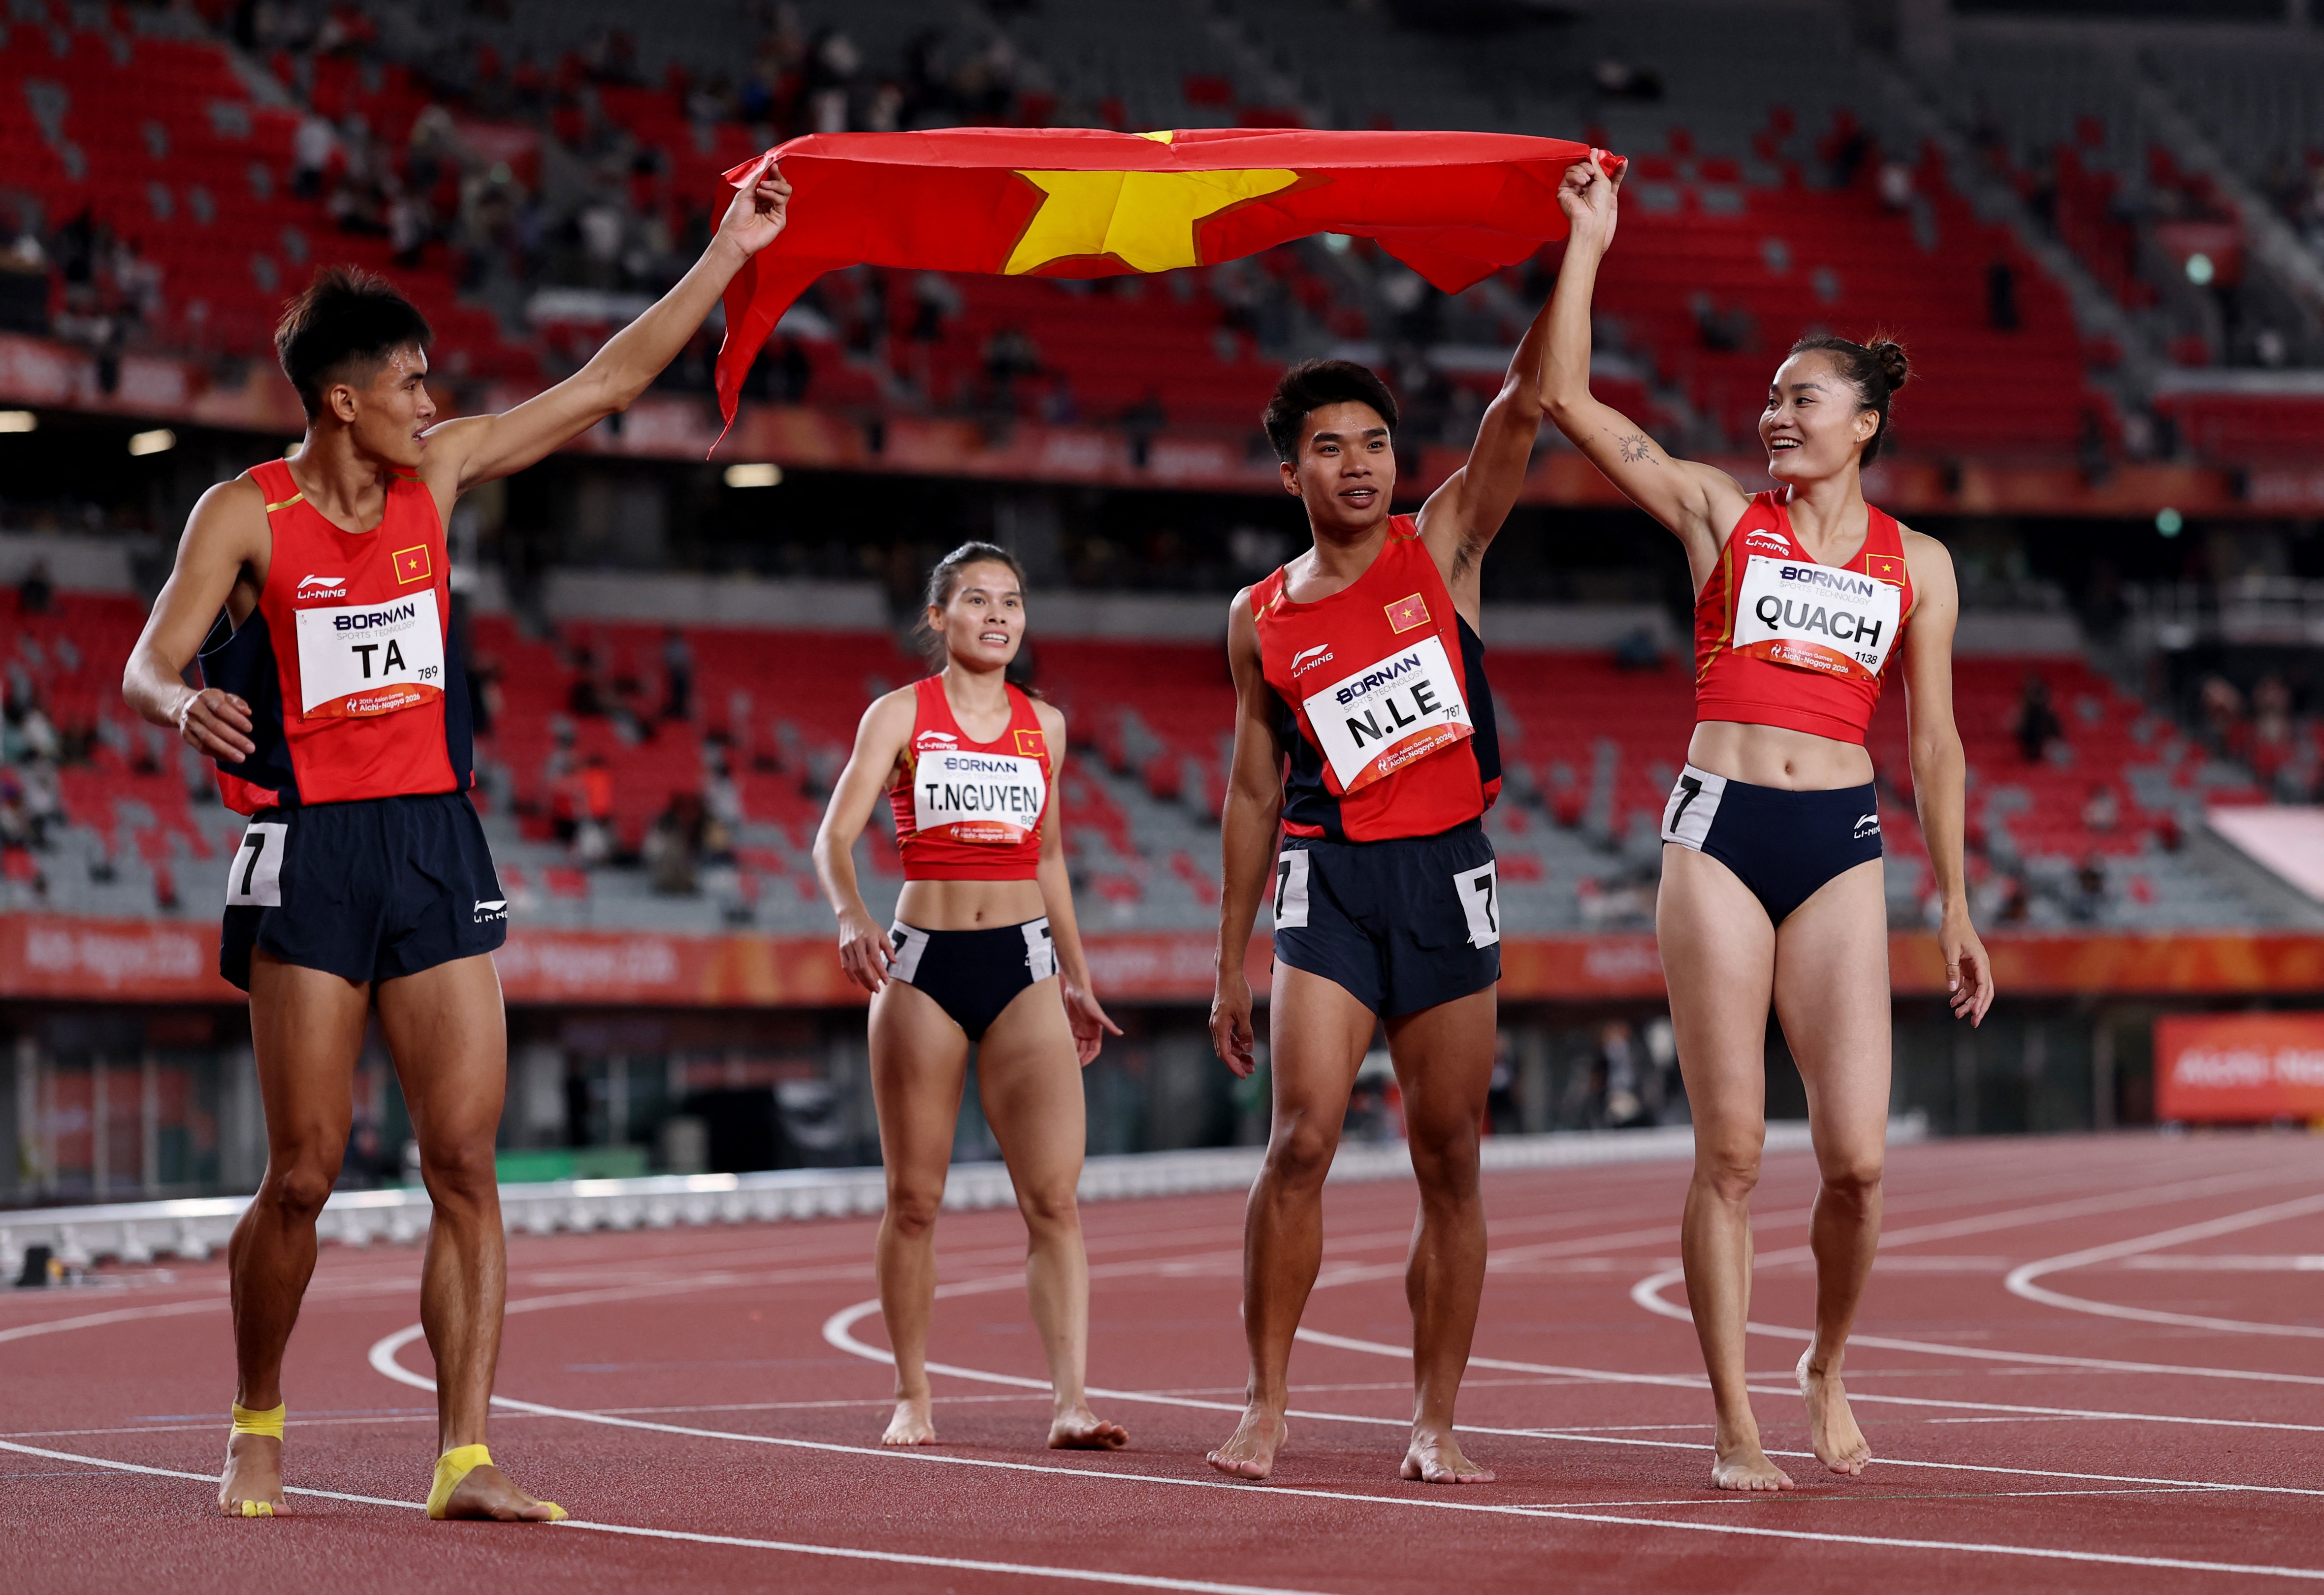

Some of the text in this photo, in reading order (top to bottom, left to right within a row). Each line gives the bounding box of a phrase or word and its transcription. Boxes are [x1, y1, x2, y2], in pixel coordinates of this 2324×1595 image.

[1745, 538, 1790, 556] LI-NING
[297, 589, 346, 599] LI-NING
[1779, 566, 1873, 597] BORNAN
[1779, 581, 1871, 606] SPORTS TECHNOLOGY
[332, 603, 415, 630] BORNAN
[1756, 595, 1882, 647] QUACH
[336, 620, 415, 640] SPORTS TECHNOLOGY
[352, 639, 406, 678] TA
[1293, 652, 1334, 678] LI-NING
[1781, 653, 1849, 673] Aichi-Nagoya 2026
[1783, 646, 1833, 663] 20th Asian Games
[1854, 651, 1878, 665] 1138
[418, 666, 438, 681] 789
[1335, 653, 1421, 705] BORNAN
[359, 694, 420, 712] Aichi-Nagoya 2026
[388, 692, 404, 700] Games
[1343, 668, 1423, 713] SPORTS TECHNOLOGY
[1346, 679, 1442, 748] N.LE
[1442, 704, 1460, 721] 787
[1387, 736, 1432, 762] 20th Asian Games
[1389, 732, 1453, 768] Aichi-Nagoya 2026
[943, 758, 1018, 773] BORNAN
[926, 784, 1037, 812] T.NGUYEN
[1670, 774, 1703, 833] 7
[241, 833, 265, 895] 7
[1276, 861, 1291, 920] 7
[1474, 873, 1496, 933] 7
